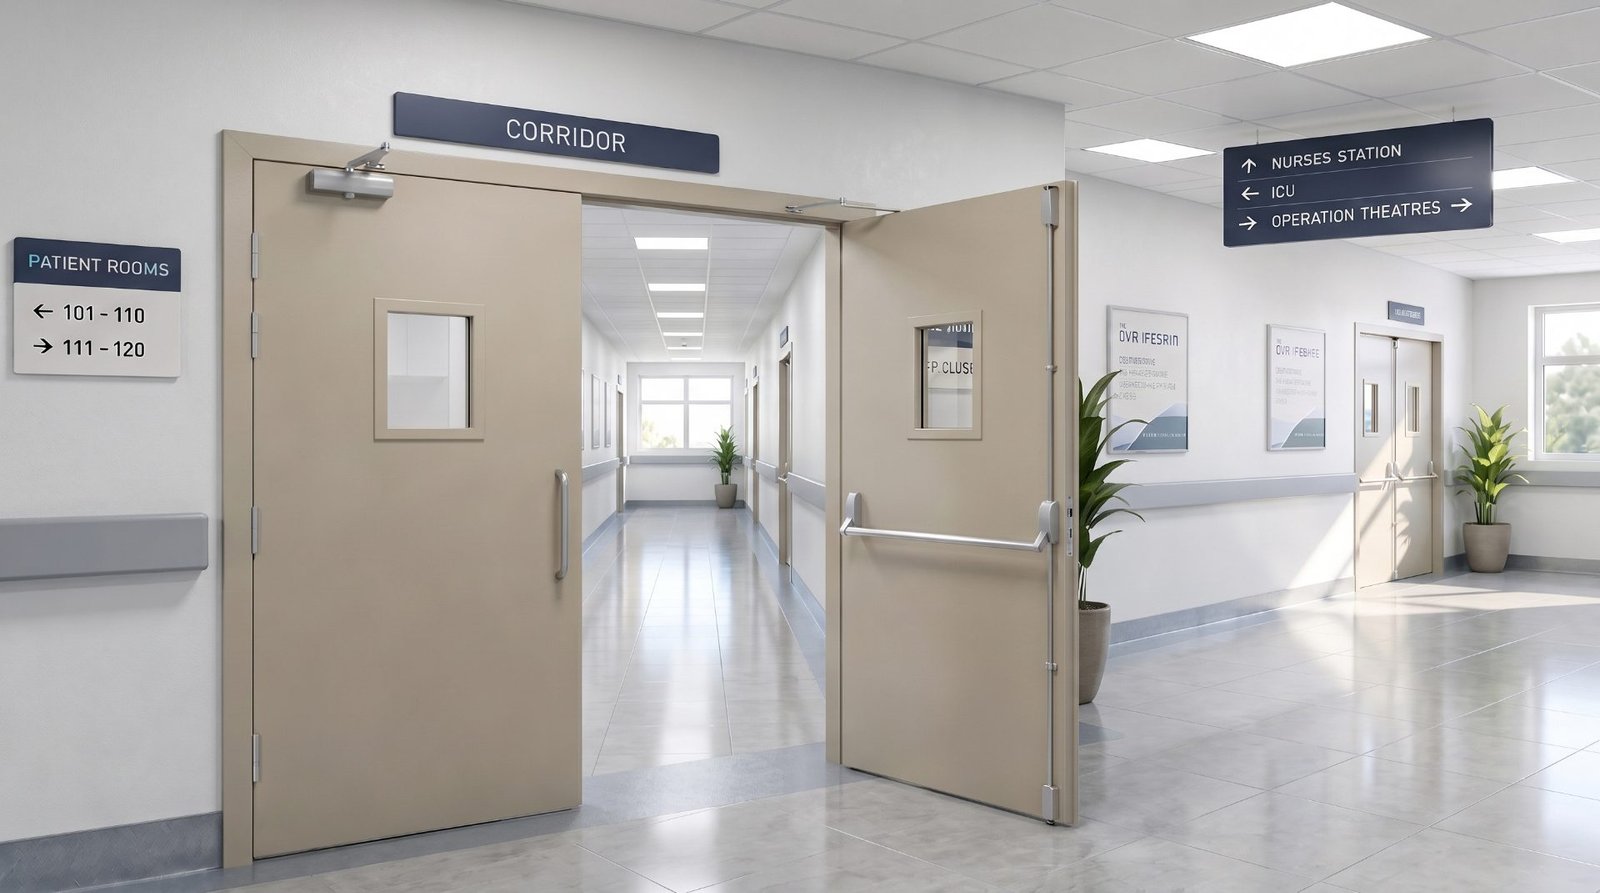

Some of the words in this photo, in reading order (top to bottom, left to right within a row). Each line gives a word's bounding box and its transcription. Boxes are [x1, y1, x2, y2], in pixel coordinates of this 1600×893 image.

[506, 118, 626, 153] CORRIDOR
[1271, 151, 1332, 170] NURSES
[1337, 144, 1402, 163] STATION
[1271, 184, 1295, 199] ICU
[1271, 208, 1354, 228] OPERATION
[1360, 200, 1441, 220] THEATRES
[28, 254, 102, 273] PATIENT
[107, 259, 169, 277] ROOMS
[63, 304, 94, 321] 101
[114, 306, 145, 324] 110
[63, 339, 93, 356] 111
[113, 340, 145, 358] 120
